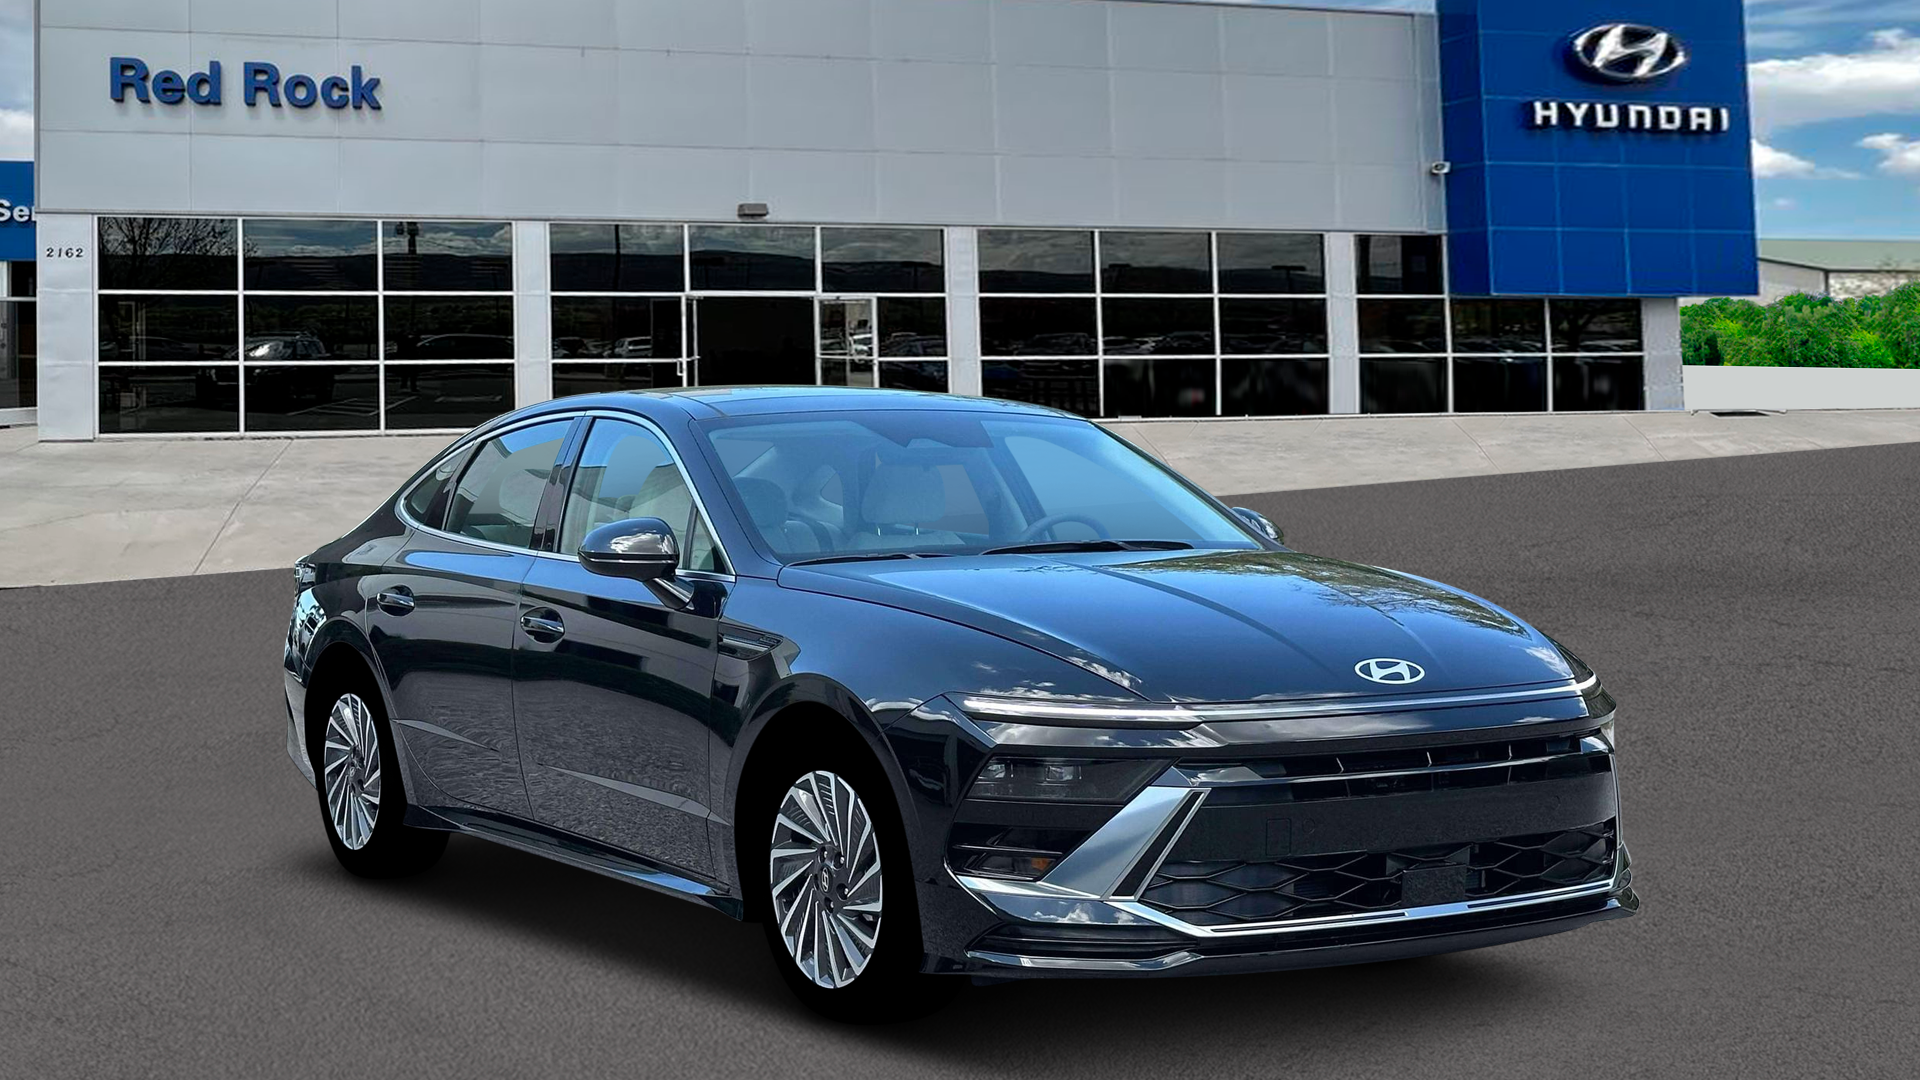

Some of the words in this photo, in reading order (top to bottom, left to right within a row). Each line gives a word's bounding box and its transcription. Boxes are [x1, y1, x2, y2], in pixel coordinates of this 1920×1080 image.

[110, 56, 222, 106] Red
[242, 61, 382, 110] Rock
[1533, 101, 1729, 131] HYUNDAI
[46, 247, 84, 258] 2162
